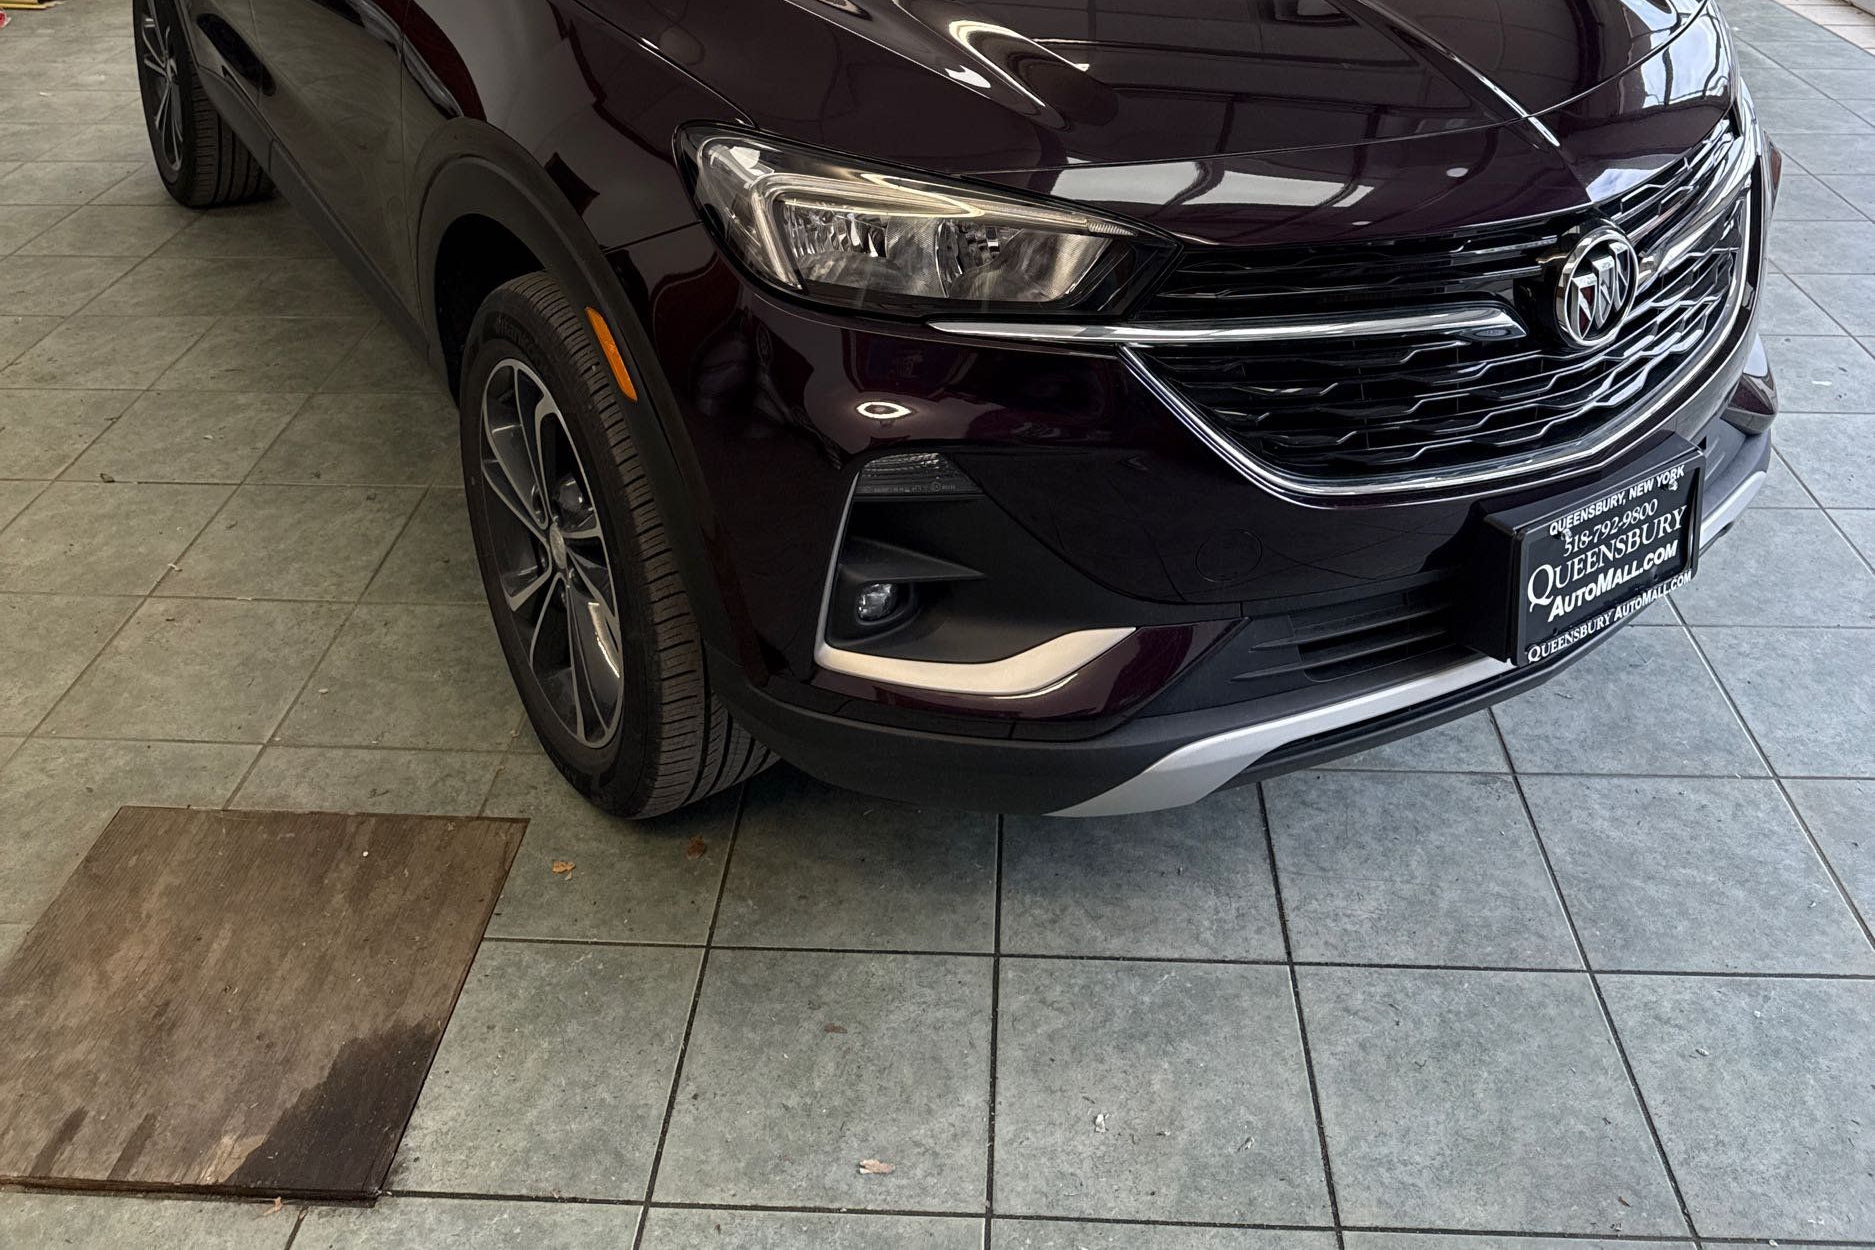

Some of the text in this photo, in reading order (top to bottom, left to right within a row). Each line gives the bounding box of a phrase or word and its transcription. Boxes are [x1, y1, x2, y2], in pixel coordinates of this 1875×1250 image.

[1549, 465, 1685, 536] QUEENSBURY, NEW YORK
[1562, 498, 1658, 557] 518-792-9800
[1527, 505, 1687, 613] QUEENSBURY
[1527, 612, 1614, 664] QUEENSBURY
